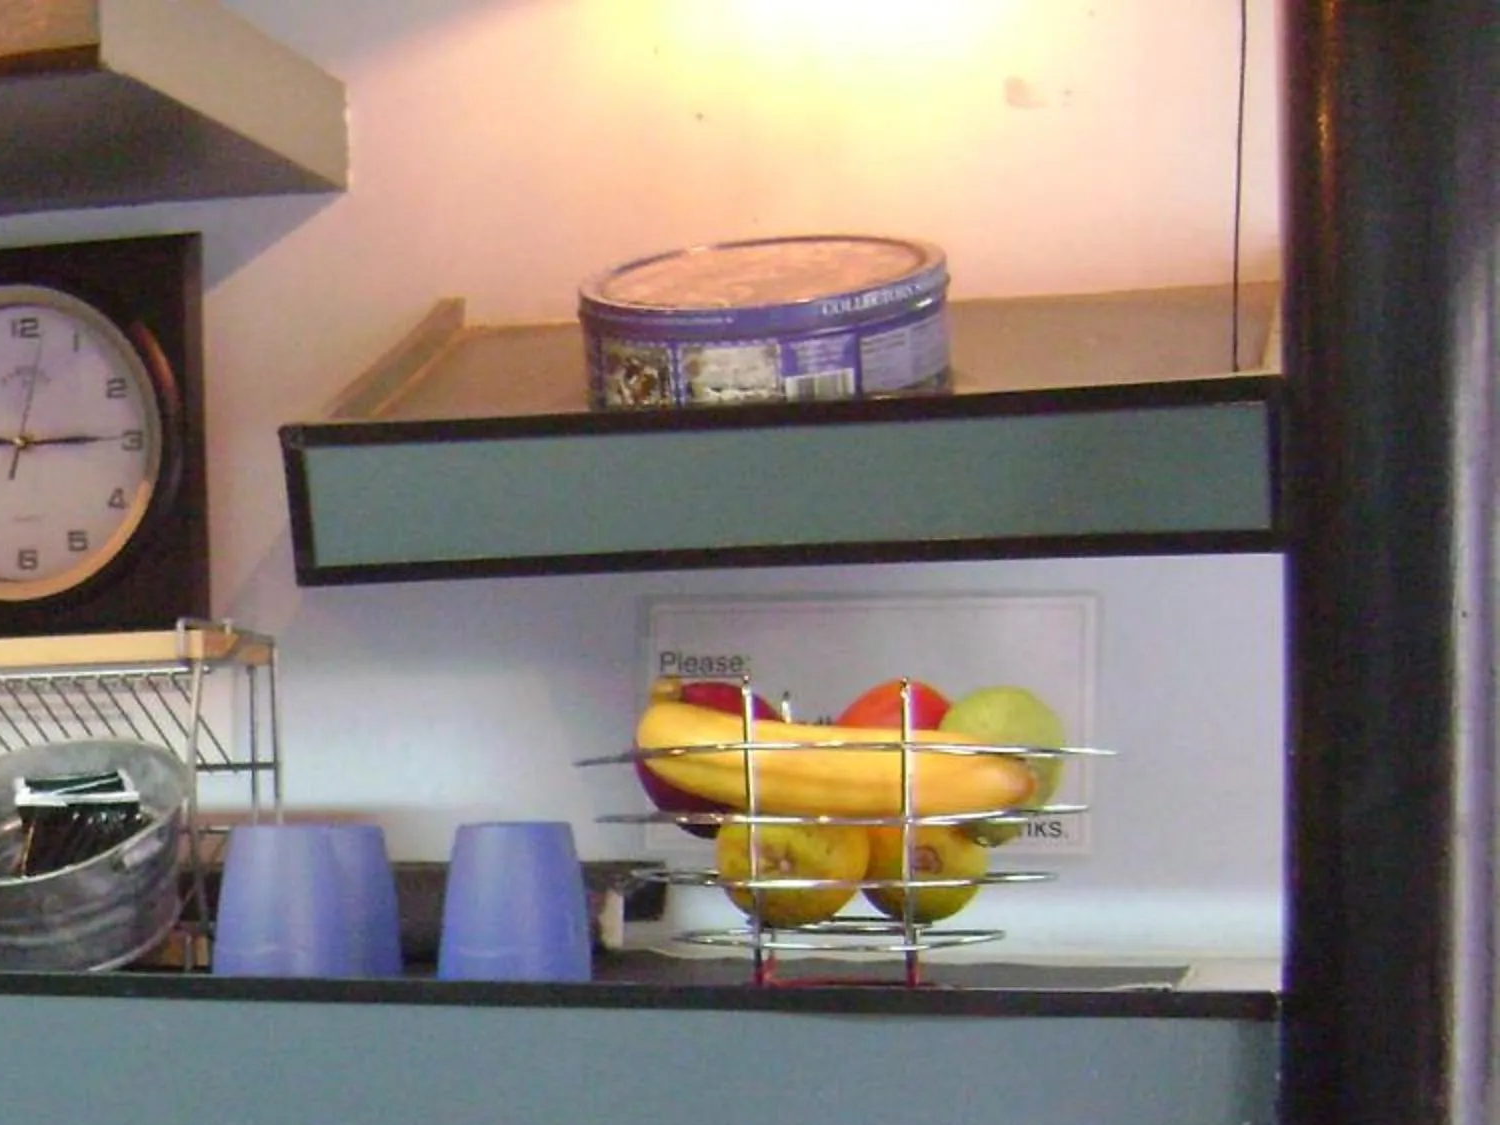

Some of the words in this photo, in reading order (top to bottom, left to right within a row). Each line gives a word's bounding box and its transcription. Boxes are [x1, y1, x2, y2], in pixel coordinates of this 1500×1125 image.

[11, 318, 39, 338] 12
[106, 377, 128, 399] 2
[121, 430, 143, 451] 3
[108, 487, 130, 509] 4
[67, 530, 88, 551] 5
[17, 550, 38, 570] 6
